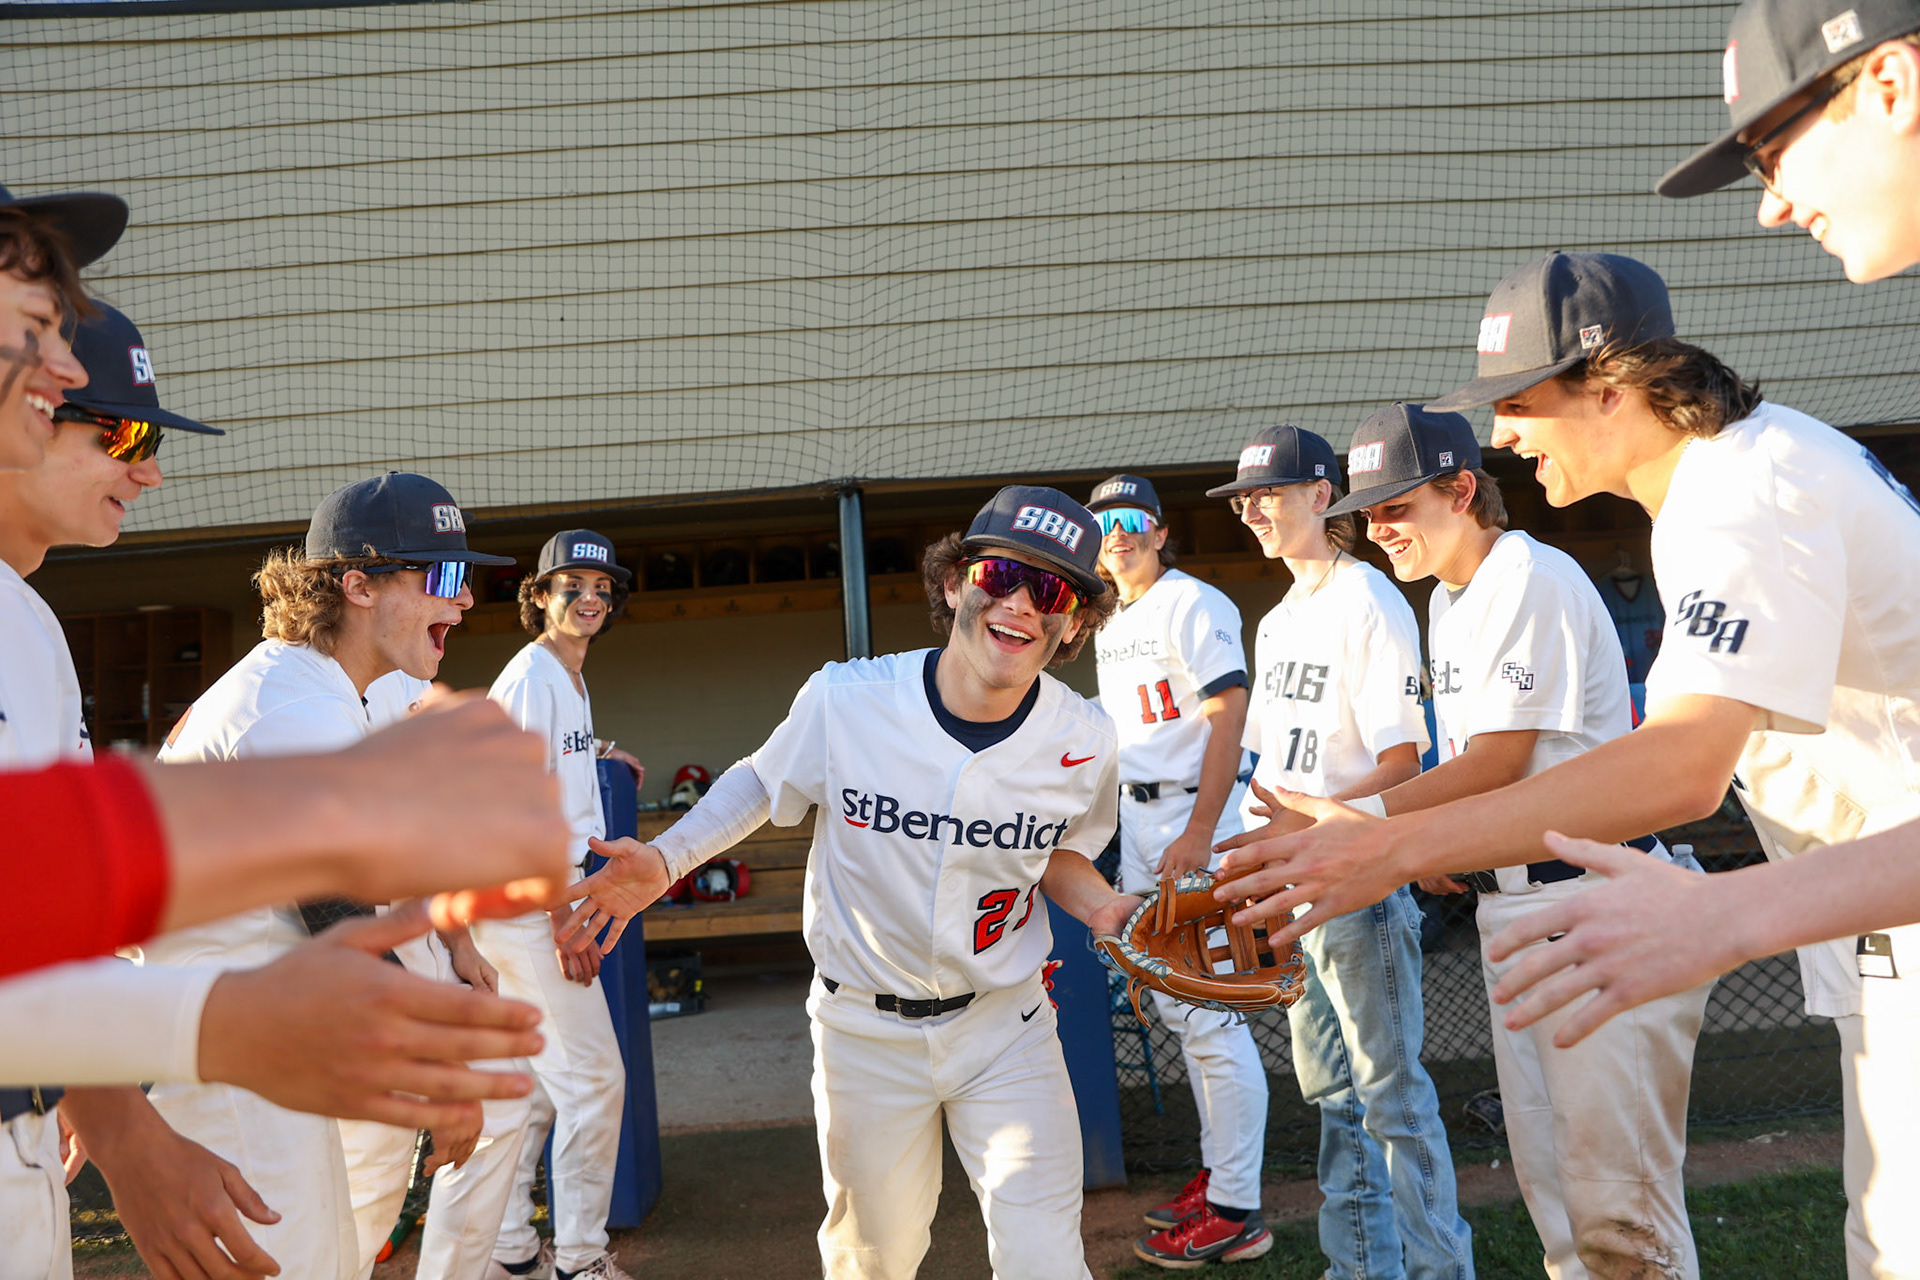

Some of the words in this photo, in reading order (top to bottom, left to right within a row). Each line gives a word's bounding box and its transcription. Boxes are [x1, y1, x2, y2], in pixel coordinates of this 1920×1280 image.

[1011, 505, 1085, 553] SBA
[572, 543, 607, 563] SBA
[1674, 590, 1749, 653] SBA
[1502, 662, 1534, 690] SBA
[1137, 679, 1180, 724] 11
[1284, 727, 1318, 774] 18
[1865, 936, 1876, 952] L
